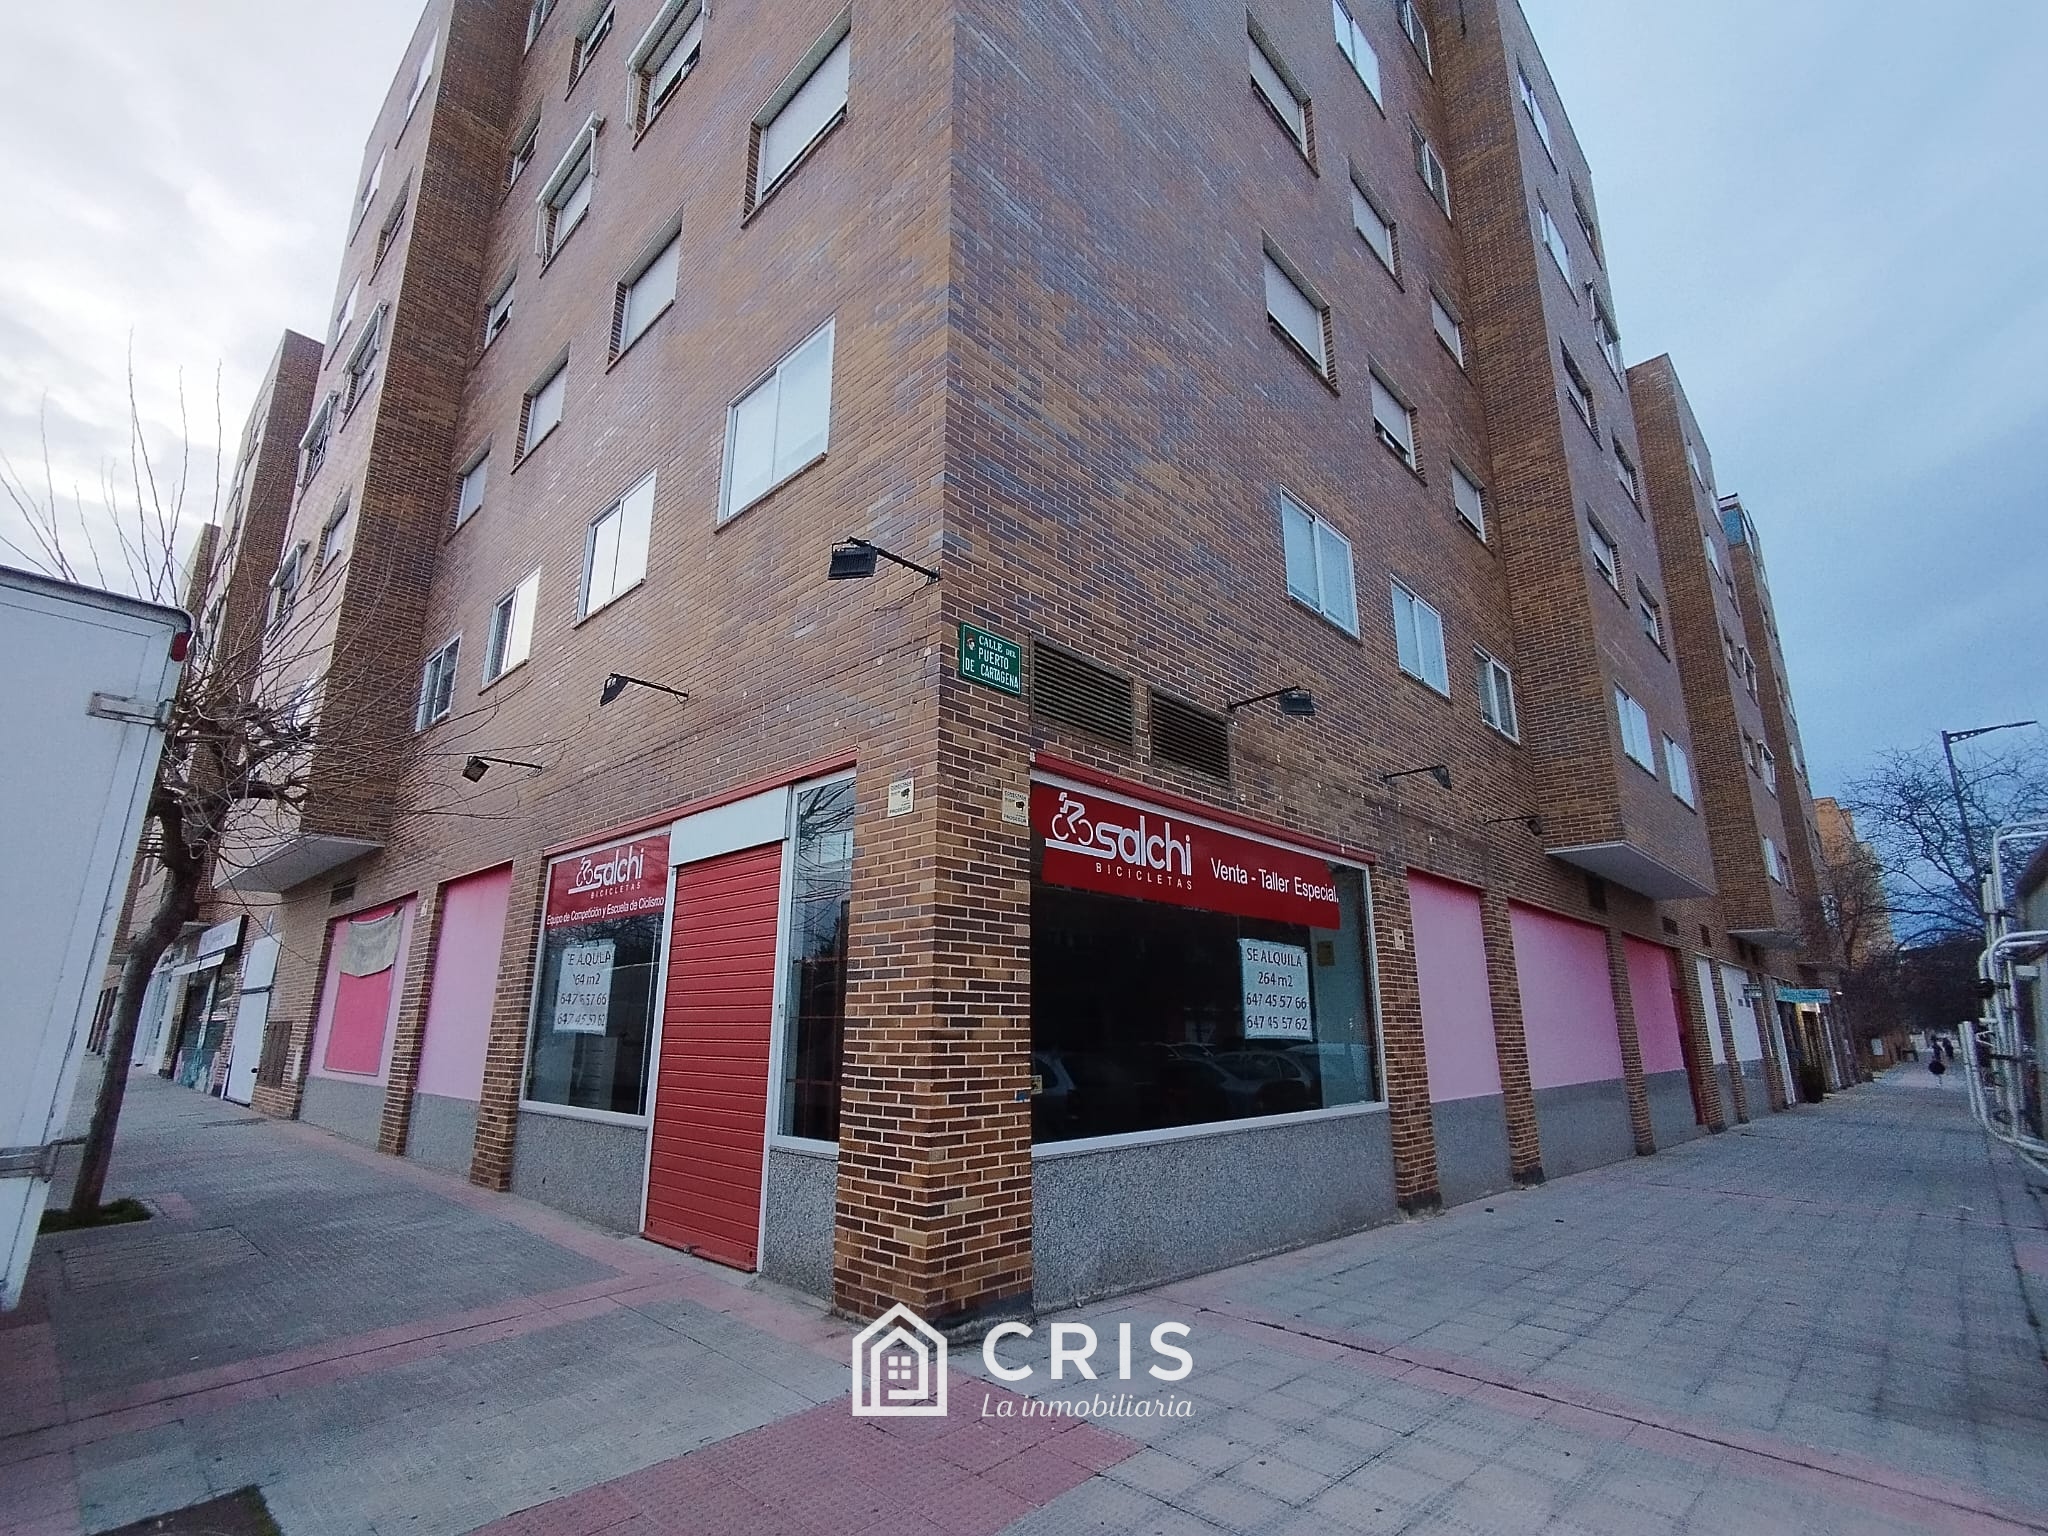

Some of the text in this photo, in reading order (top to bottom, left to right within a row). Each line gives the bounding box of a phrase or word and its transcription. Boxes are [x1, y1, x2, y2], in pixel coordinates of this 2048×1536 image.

[978, 635, 1017, 659] CALLE DEL
[978, 647, 1009, 670] PUERTO
[965, 657, 1019, 689] DE CARTAGENA
[1045, 815, 1192, 876] salchi
[568, 845, 645, 894] salchi
[1096, 862, 1192, 890] BICICLETAS
[1210, 857, 1248, 885] Venta
[1258, 868, 1290, 893] Taller
[590, 881, 641, 899] BICICLETAS
[546, 896, 665, 926] Equipo de Competición y Escuela de Ciclismo
[577, 950, 611, 967] ALQULA
[1246, 947, 1303, 967] SE ALQUILA
[586, 972, 601, 985] m2
[1258, 971, 1293, 987] 264 m2
[561, 993, 579, 1005] 647
[597, 993, 607, 1005] 66
[1246, 992, 1308, 1010] 647 45 57 66
[558, 1012, 575, 1025] 647
[1247, 1015, 1308, 1030] 647 45 57 62
